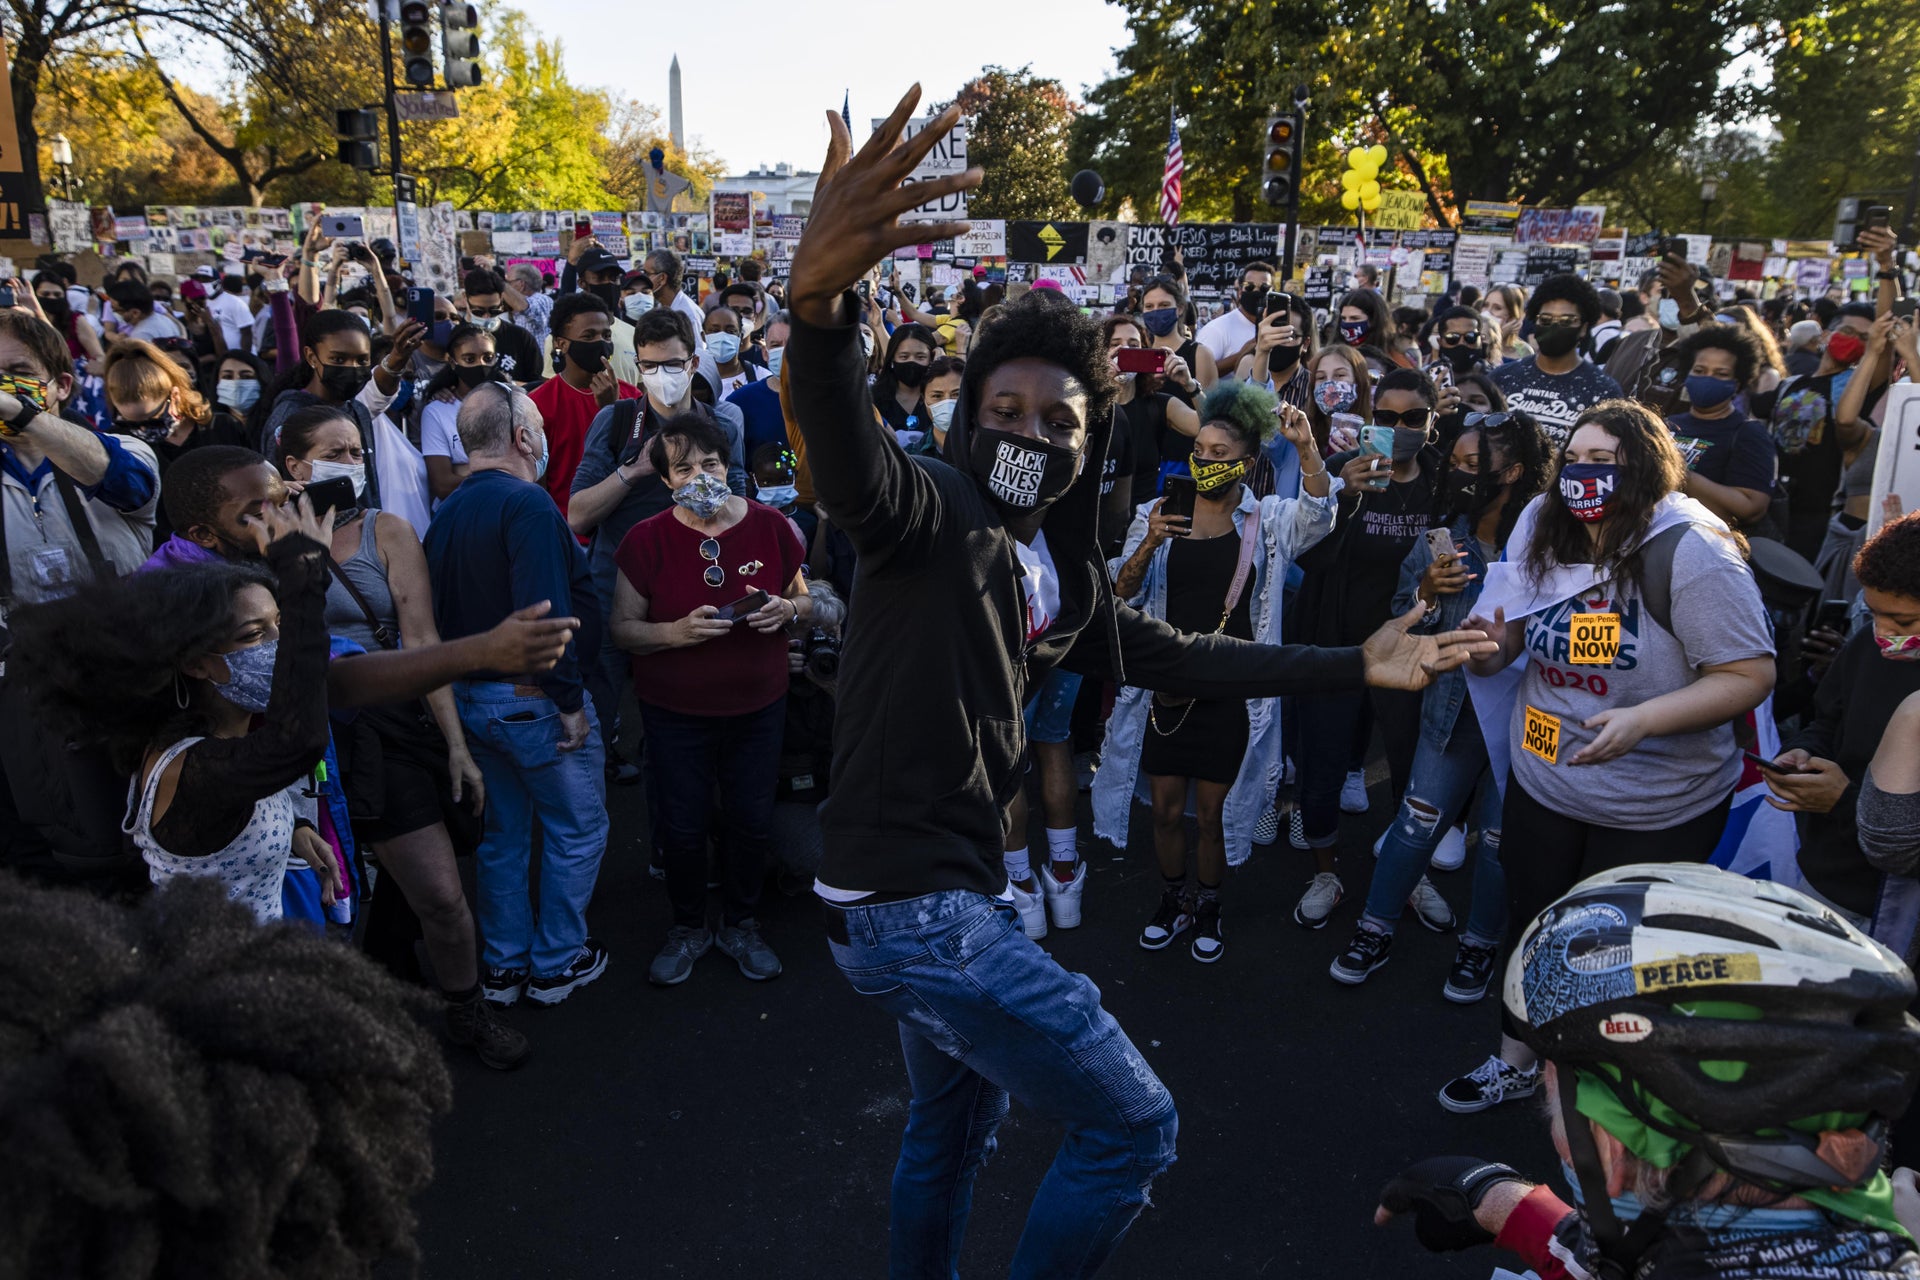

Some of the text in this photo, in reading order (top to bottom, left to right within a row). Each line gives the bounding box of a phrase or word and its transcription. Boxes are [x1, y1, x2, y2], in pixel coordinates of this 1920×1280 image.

[901, 174, 967, 213] RED!
[971, 222, 992, 231] JOIN
[961, 233, 1002, 242] CAMPAIGN
[1128, 227, 1165, 245] FUCK
[1168, 227, 1207, 246] JESUS
[1230, 228, 1253, 244] Black
[971, 243, 992, 254] ZERO
[1127, 247, 1163, 264] YOUR
[1184, 246, 1271, 259] NEED MORE THAN
[772, 261, 791, 269] REMO
[1049, 268, 1066, 277] WE
[1184, 262, 1211, 281] ughts
[681, 277, 696, 291] OP
[1522, 387, 1560, 400] #VINTAGE
[632, 411, 643, 438] Canon
[998, 443, 1044, 471] BLACK
[992, 461, 1040, 491] LIVES
[1199, 474, 1233, 490] ROSS
[988, 479, 1036, 507] MATTER
[1560, 475, 1613, 499] BIDEN
[1363, 511, 1404, 526] MICHELLE
[1406, 514, 1415, 523] IS
[1366, 523, 1380, 535] MY
[1383, 526, 1407, 537] FIRST
[1577, 626, 1615, 641] OUT
[1526, 622, 1638, 671] HARS
[1573, 642, 1618, 658] NOW
[1529, 719, 1555, 742] OUT
[1526, 731, 1557, 757] NOW
[1641, 958, 1730, 988] PEACE
[1605, 1021, 1643, 1035] BELL
[1758, 1239, 1819, 1265] MAYBE
[1756, 1266, 1841, 1280] PROBLEM
